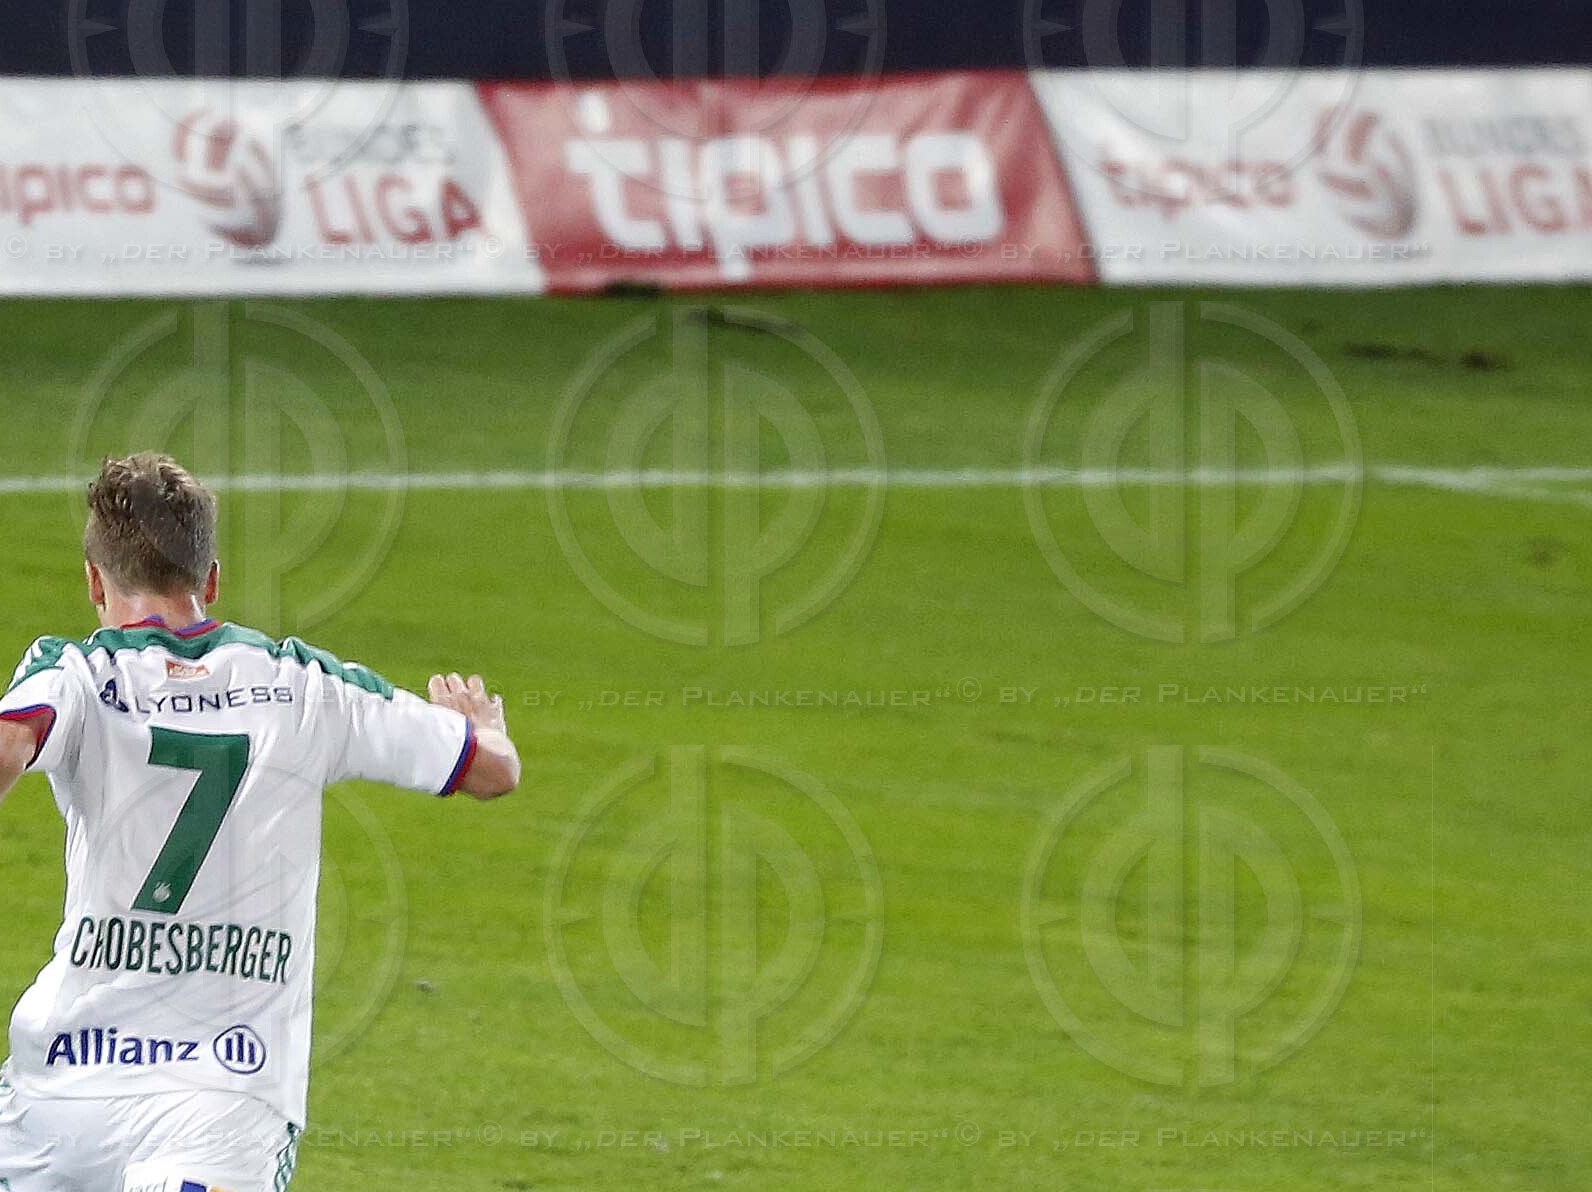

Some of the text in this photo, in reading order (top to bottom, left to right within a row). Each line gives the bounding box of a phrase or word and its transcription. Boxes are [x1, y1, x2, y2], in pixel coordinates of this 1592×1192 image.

[304, 174, 481, 246] LIGA
[563, 90, 1006, 282] tipico
[135, 687, 292, 714] LYONESS
[131, 726, 250, 916] 7
[45, 1025, 200, 1067] Allianz
